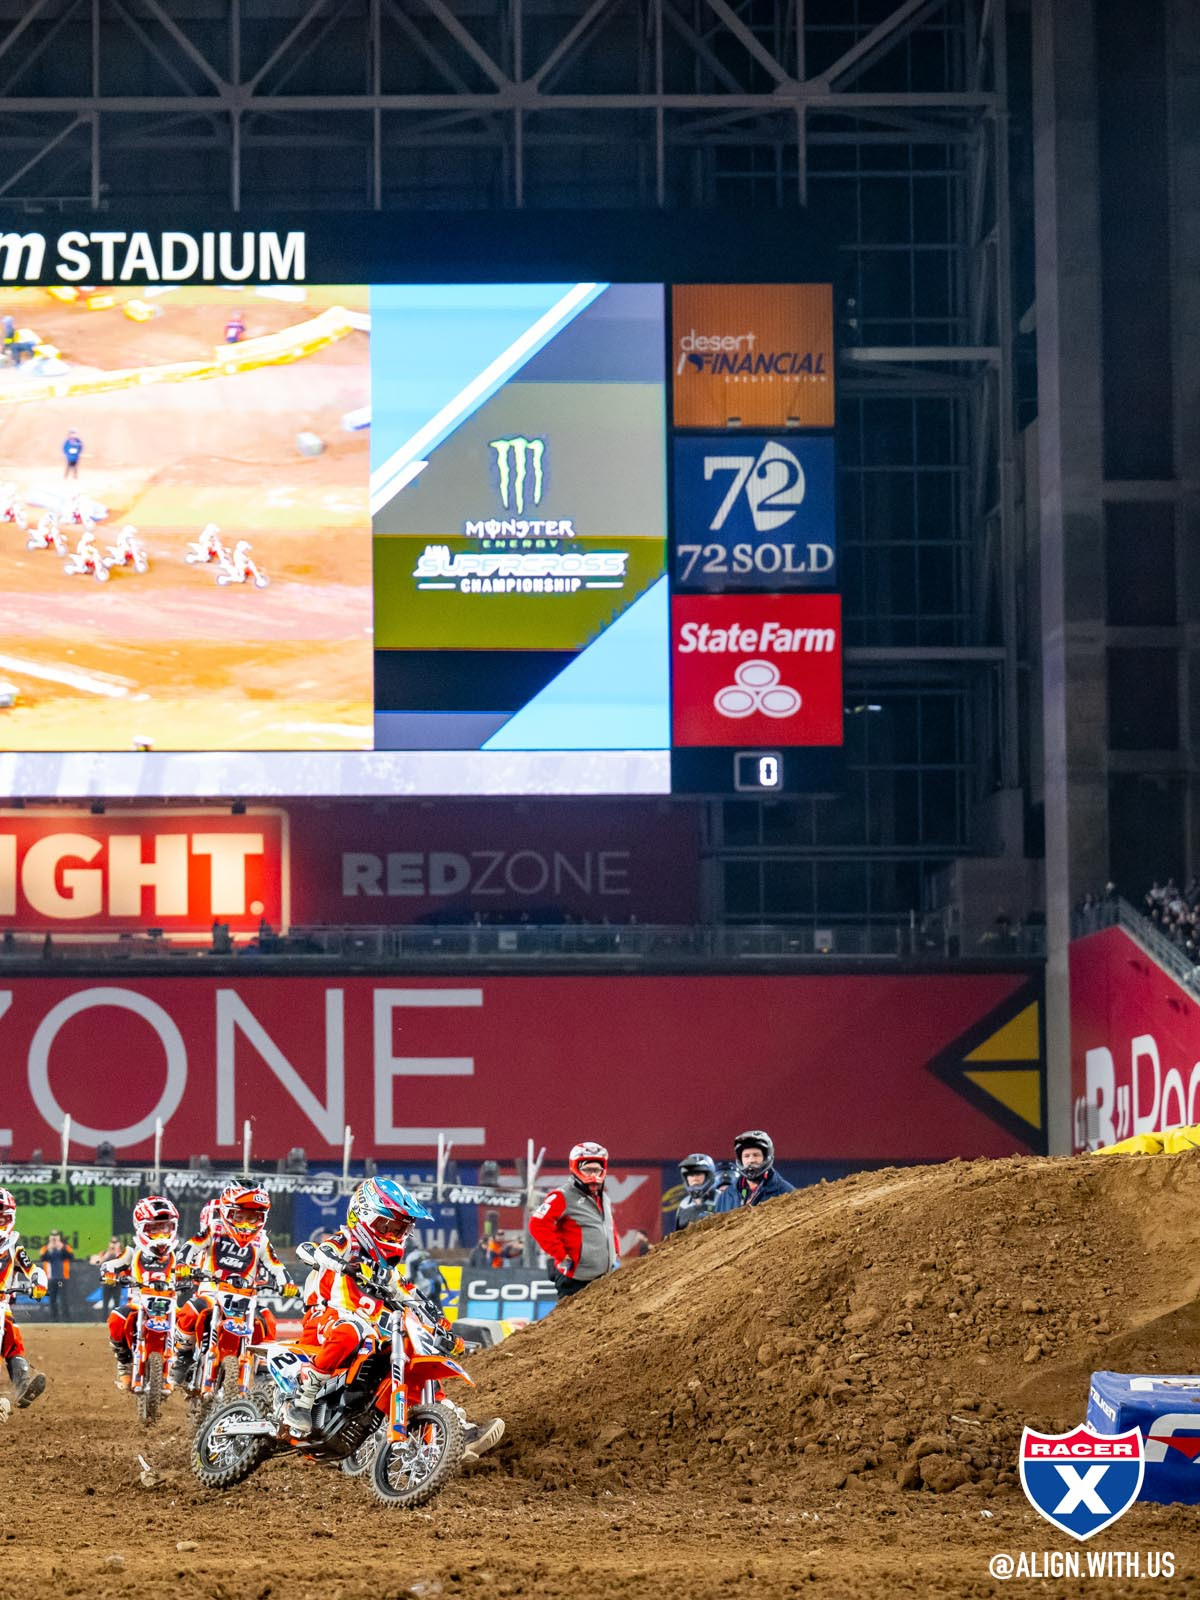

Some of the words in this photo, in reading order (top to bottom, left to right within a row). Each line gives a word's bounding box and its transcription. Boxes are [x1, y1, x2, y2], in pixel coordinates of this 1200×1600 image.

[56, 230, 306, 281] STADIUM
[680, 328, 756, 351] desert
[465, 519, 575, 538] MONSTER
[459, 578, 581, 593] CHAMPIONSHIP
[759, 757, 778, 786] 0
[221, 1240, 249, 1257] TLD
[220, 1257, 244, 1269] KTM
